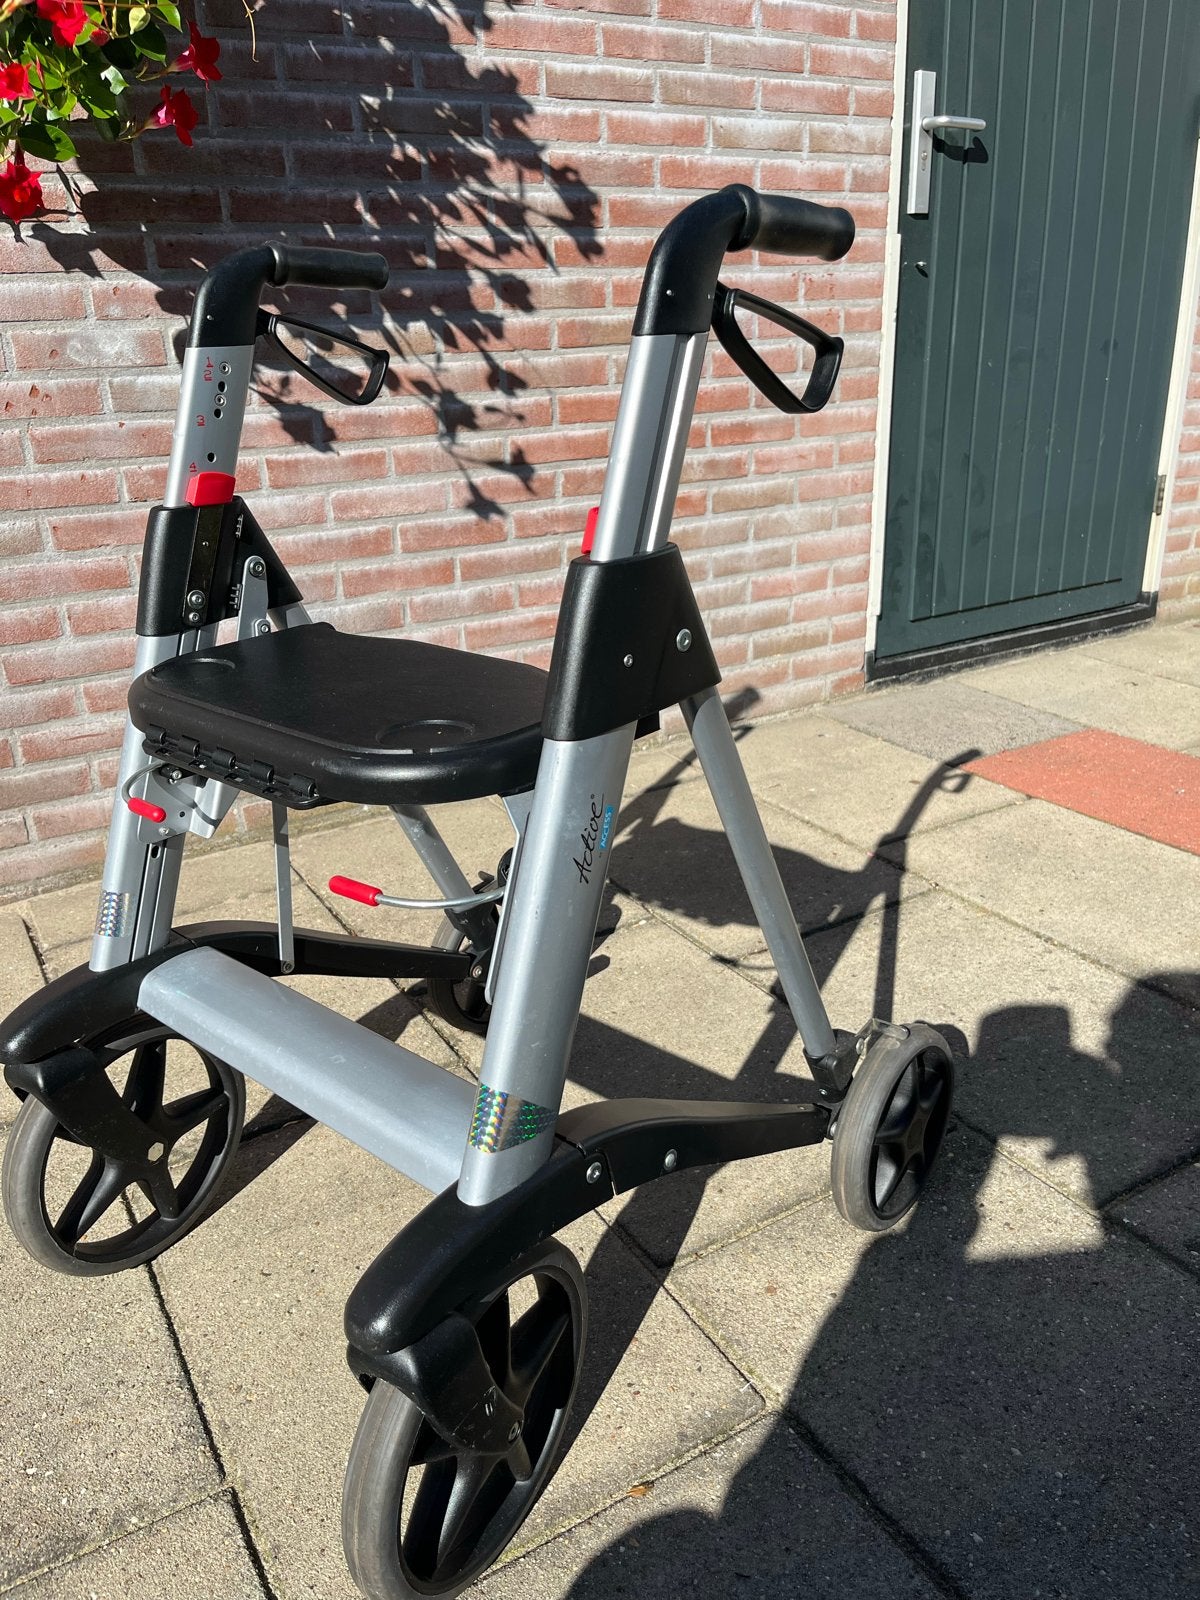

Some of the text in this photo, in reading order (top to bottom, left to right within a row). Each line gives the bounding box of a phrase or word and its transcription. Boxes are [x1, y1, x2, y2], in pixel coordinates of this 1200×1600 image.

[203, 370, 213, 381] 2
[196, 414, 205, 426] 3
[189, 461, 197, 472] 4
